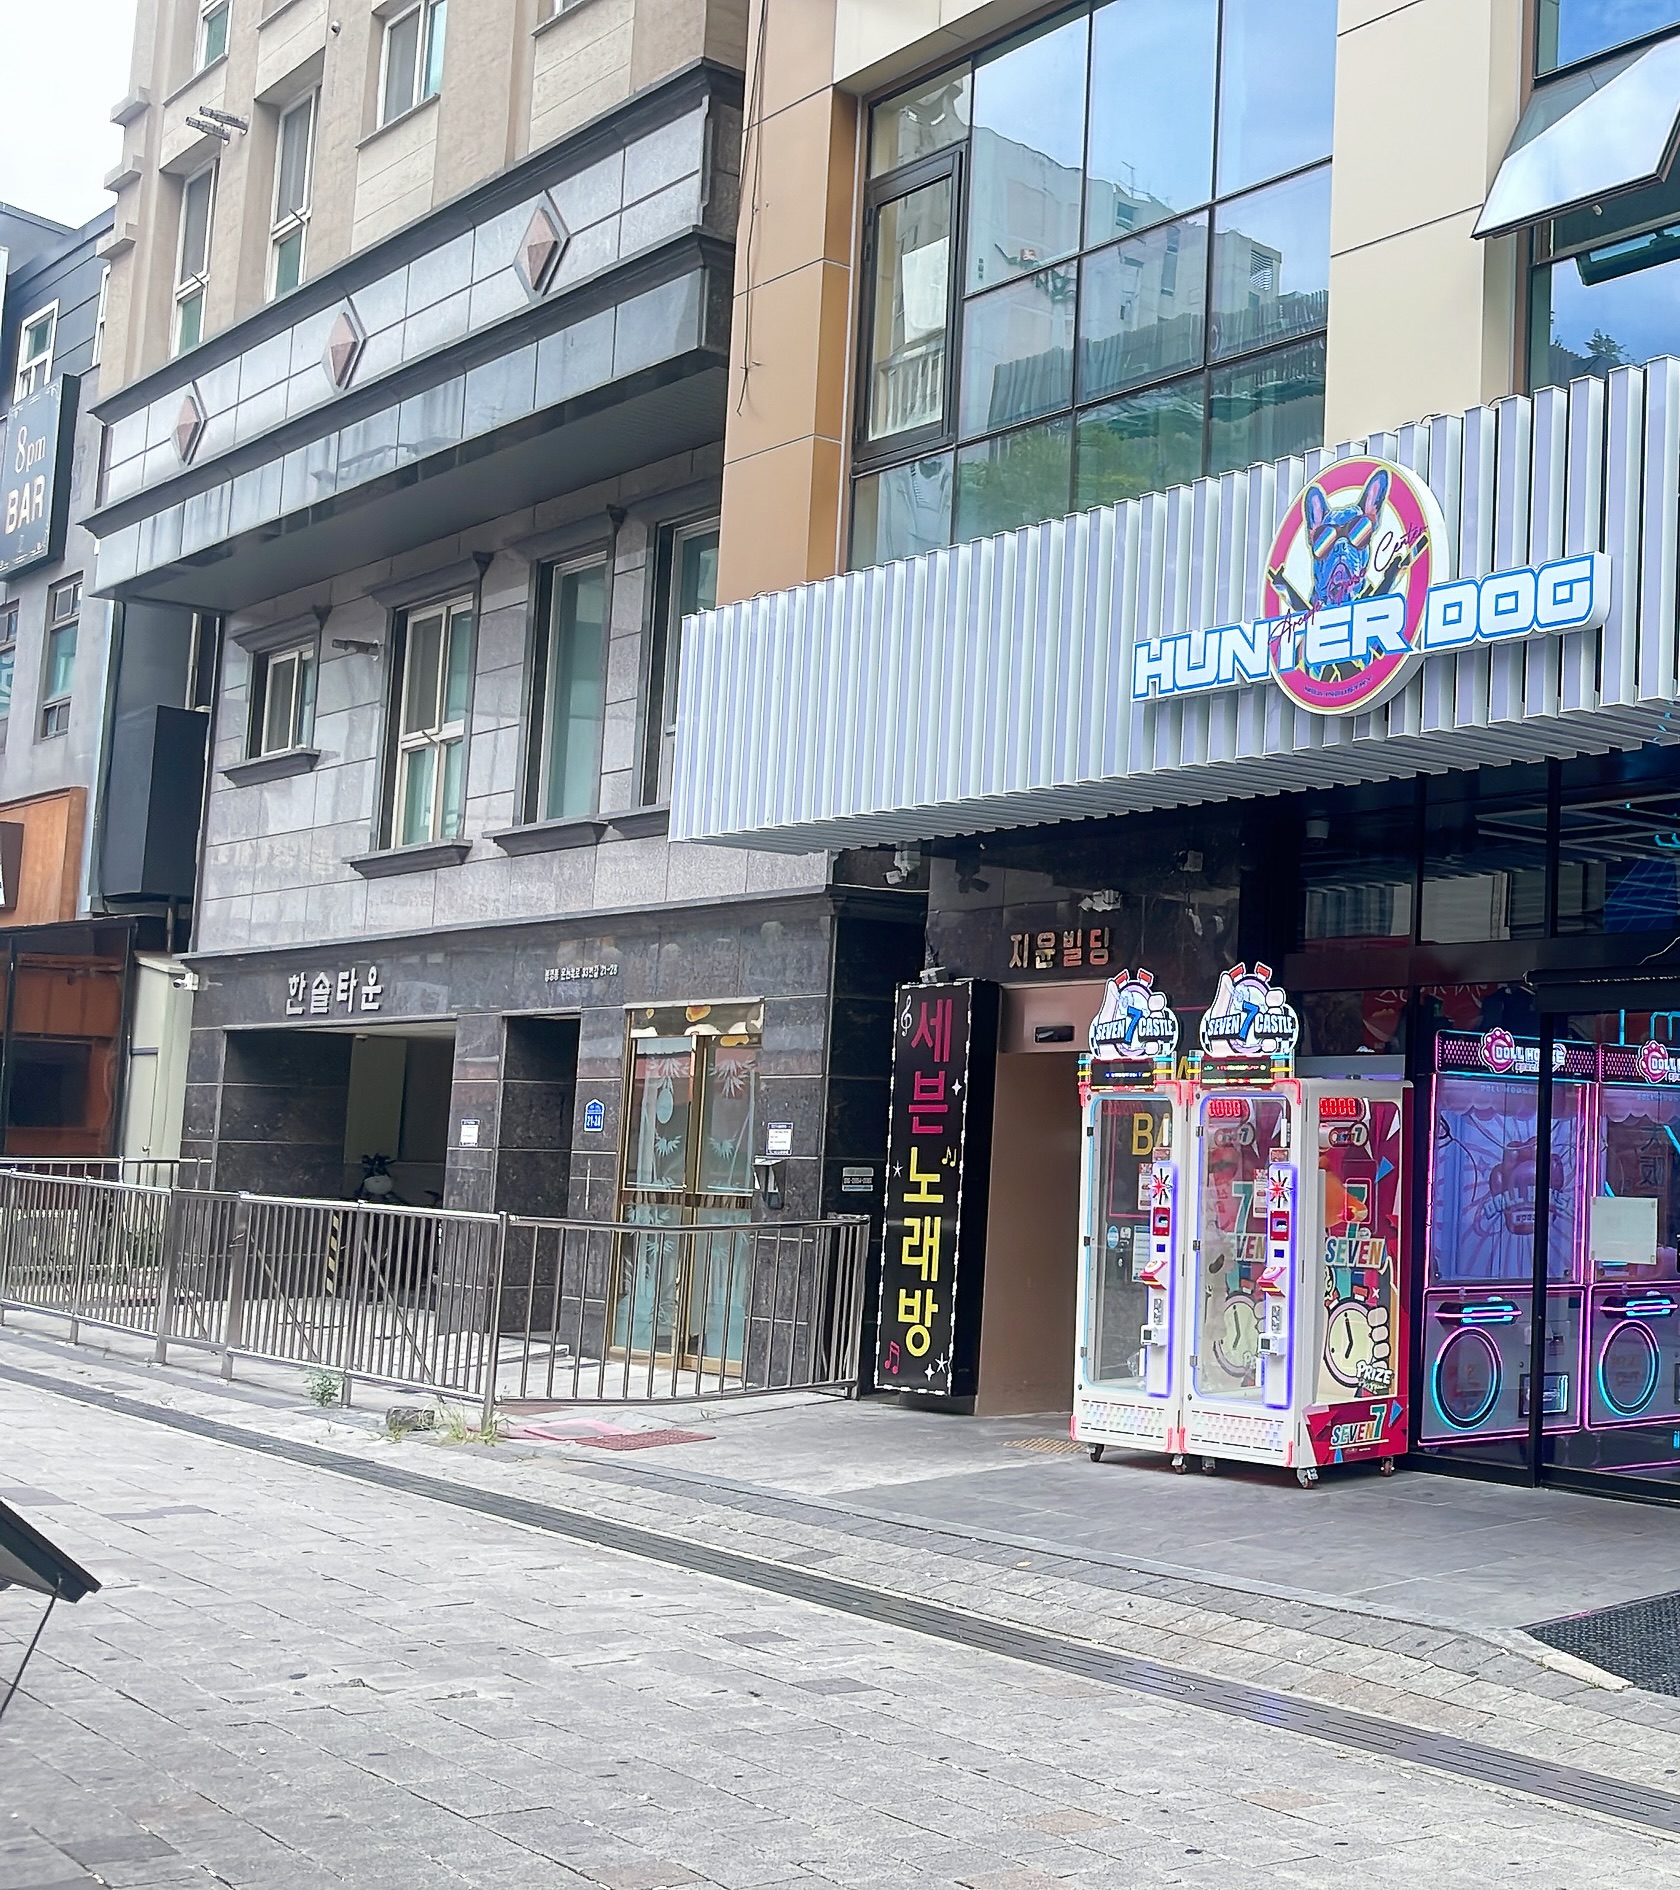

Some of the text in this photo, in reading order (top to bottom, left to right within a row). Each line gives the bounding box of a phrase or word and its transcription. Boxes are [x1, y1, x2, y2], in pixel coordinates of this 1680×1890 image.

[15, 425, 46, 474] 8pm
[5, 475, 46, 535] BAR
[1132, 553, 1595, 699] HUNTER DOG
[1009, 926, 1110, 969] 지윤빌딩
[286, 965, 383, 1015] 한솔타운
[1096, 1005, 1175, 1044] SEVEN 7 CASTLE
[1207, 1001, 1295, 1043] SEVEN 7 CASTLE
[1495, 1045, 1524, 1062] DOLL
[1650, 1056, 1676, 1074] DOLL
[1325, 1238, 1384, 1267] SEVEN
[1356, 1361, 1392, 1384] PRIZE
[1331, 1404, 1387, 1445] SEVEN 7
